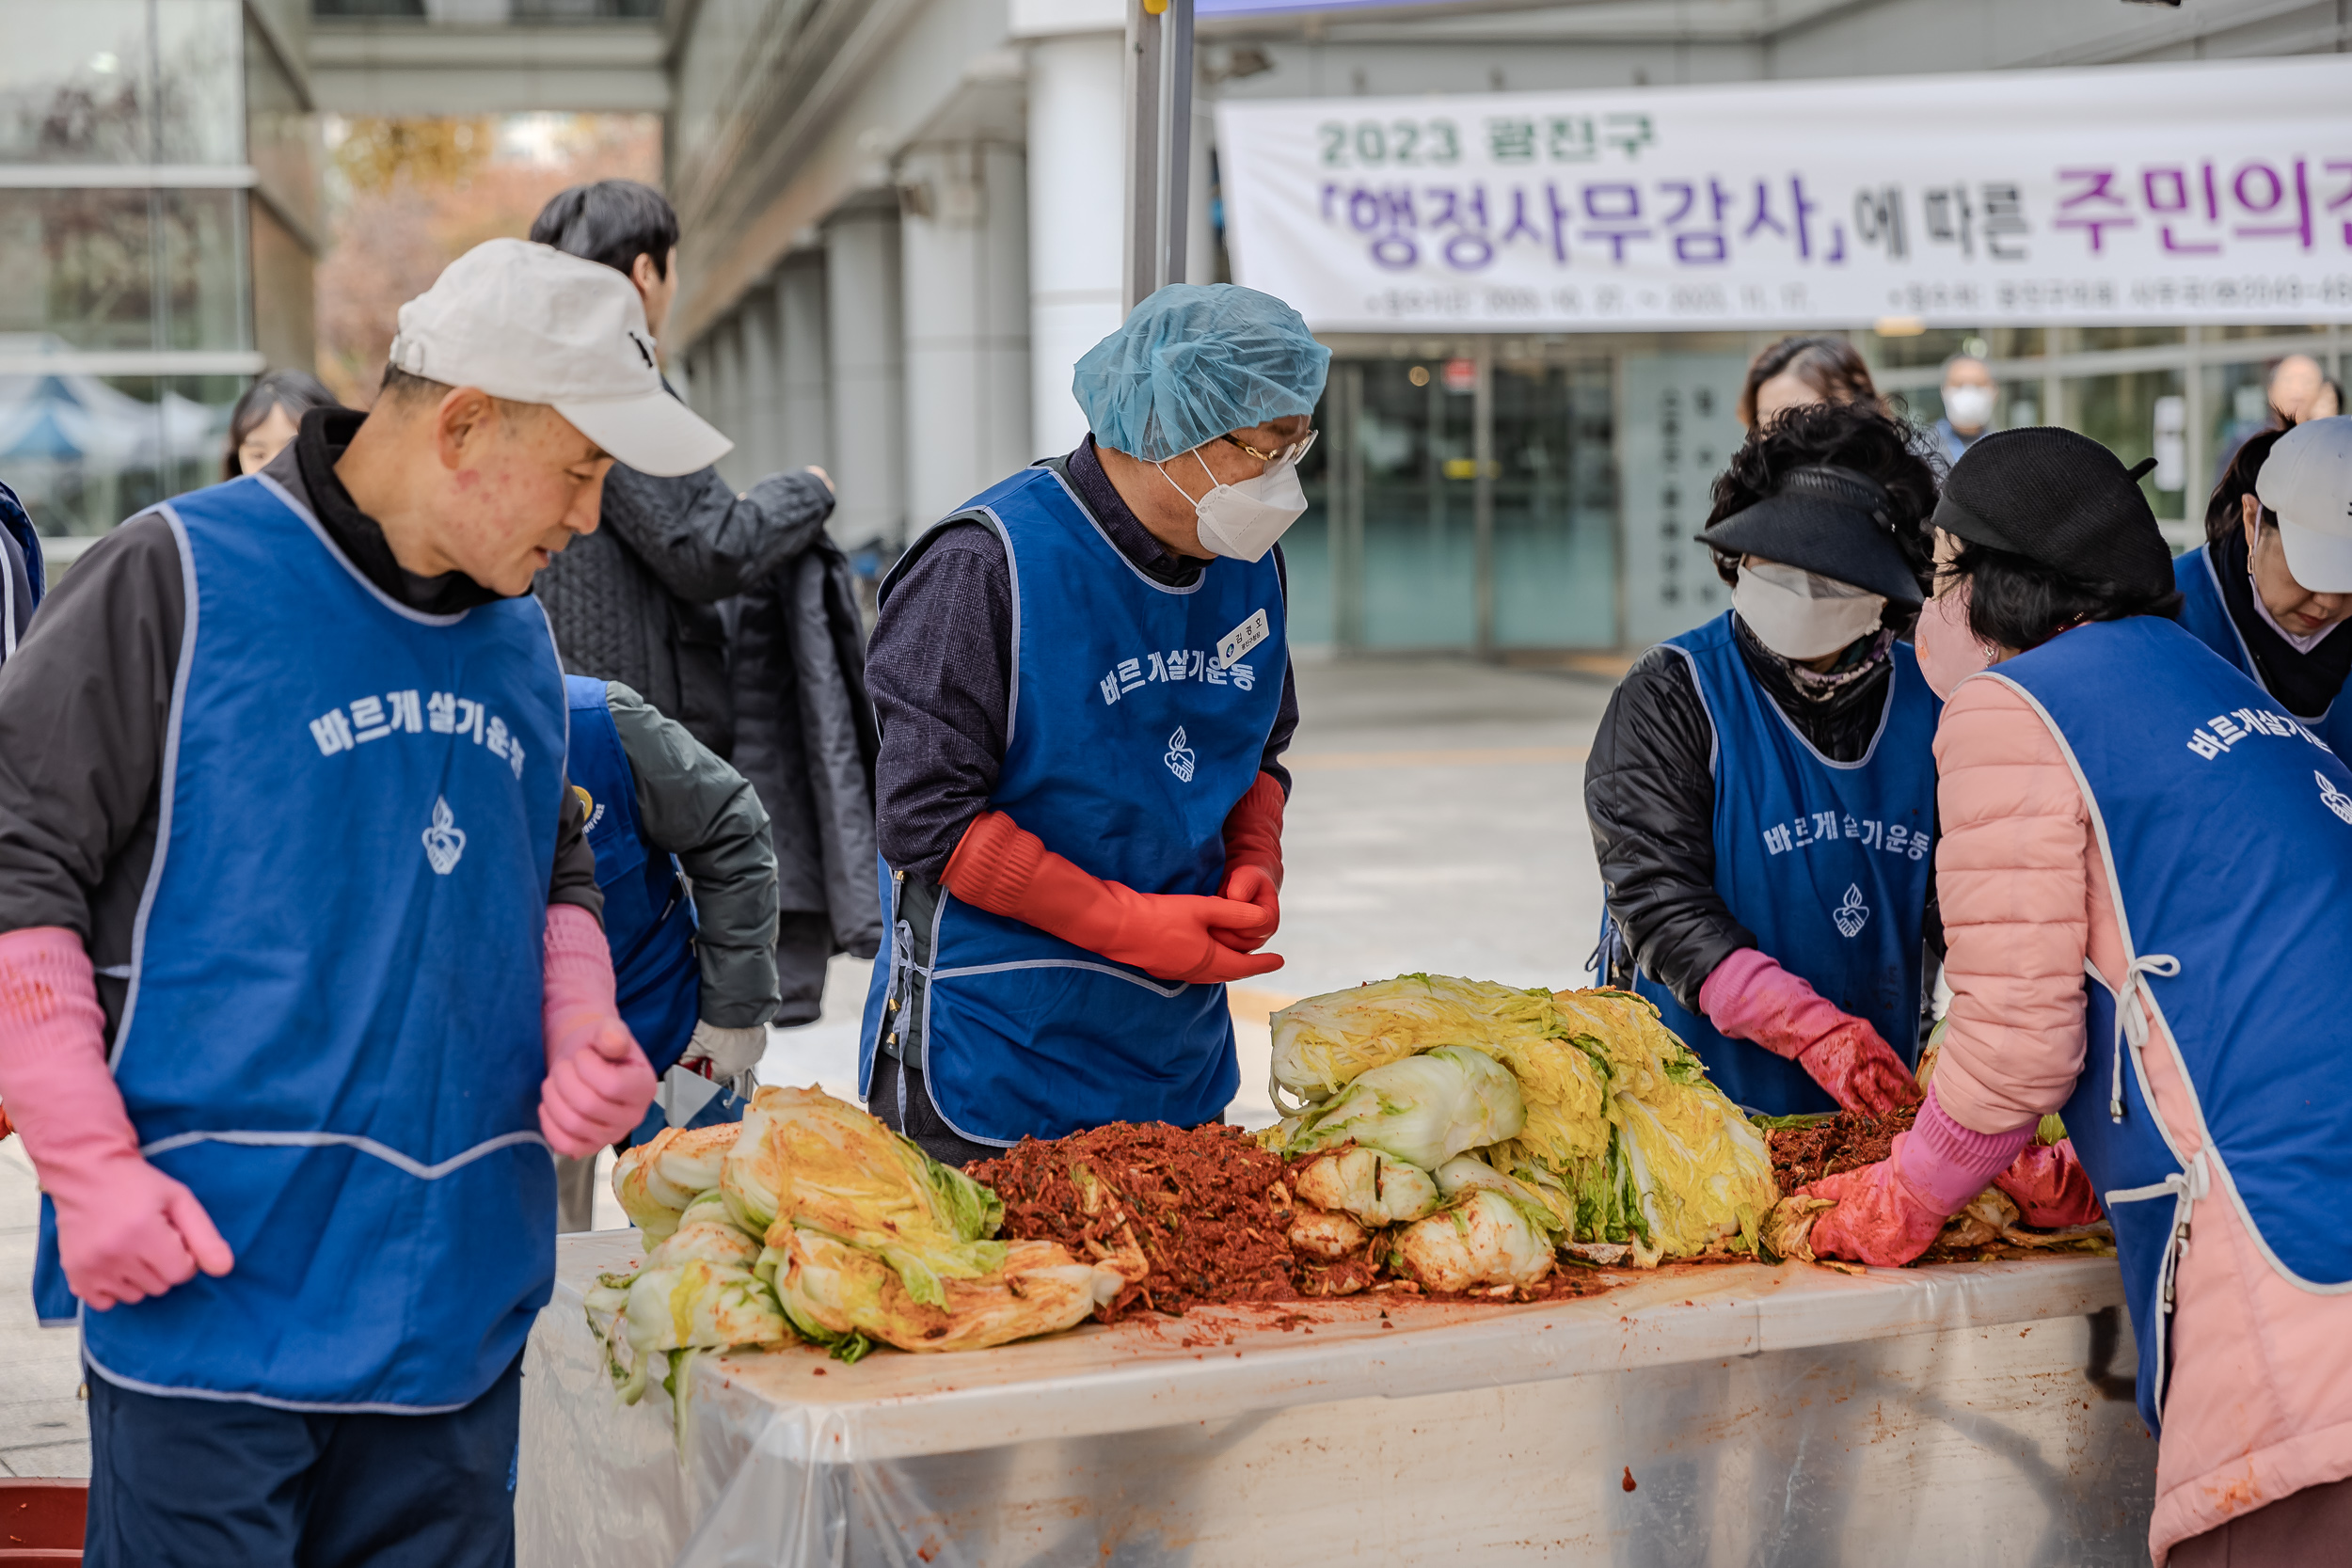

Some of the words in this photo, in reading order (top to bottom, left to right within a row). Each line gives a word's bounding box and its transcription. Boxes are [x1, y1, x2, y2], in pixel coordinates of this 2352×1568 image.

[1319, 120, 1461, 166] 2023
[1486, 111, 1658, 164] 광진구
[1922, 182, 2031, 261] 따른
[1100, 649, 1256, 705] 바르게살기운동
